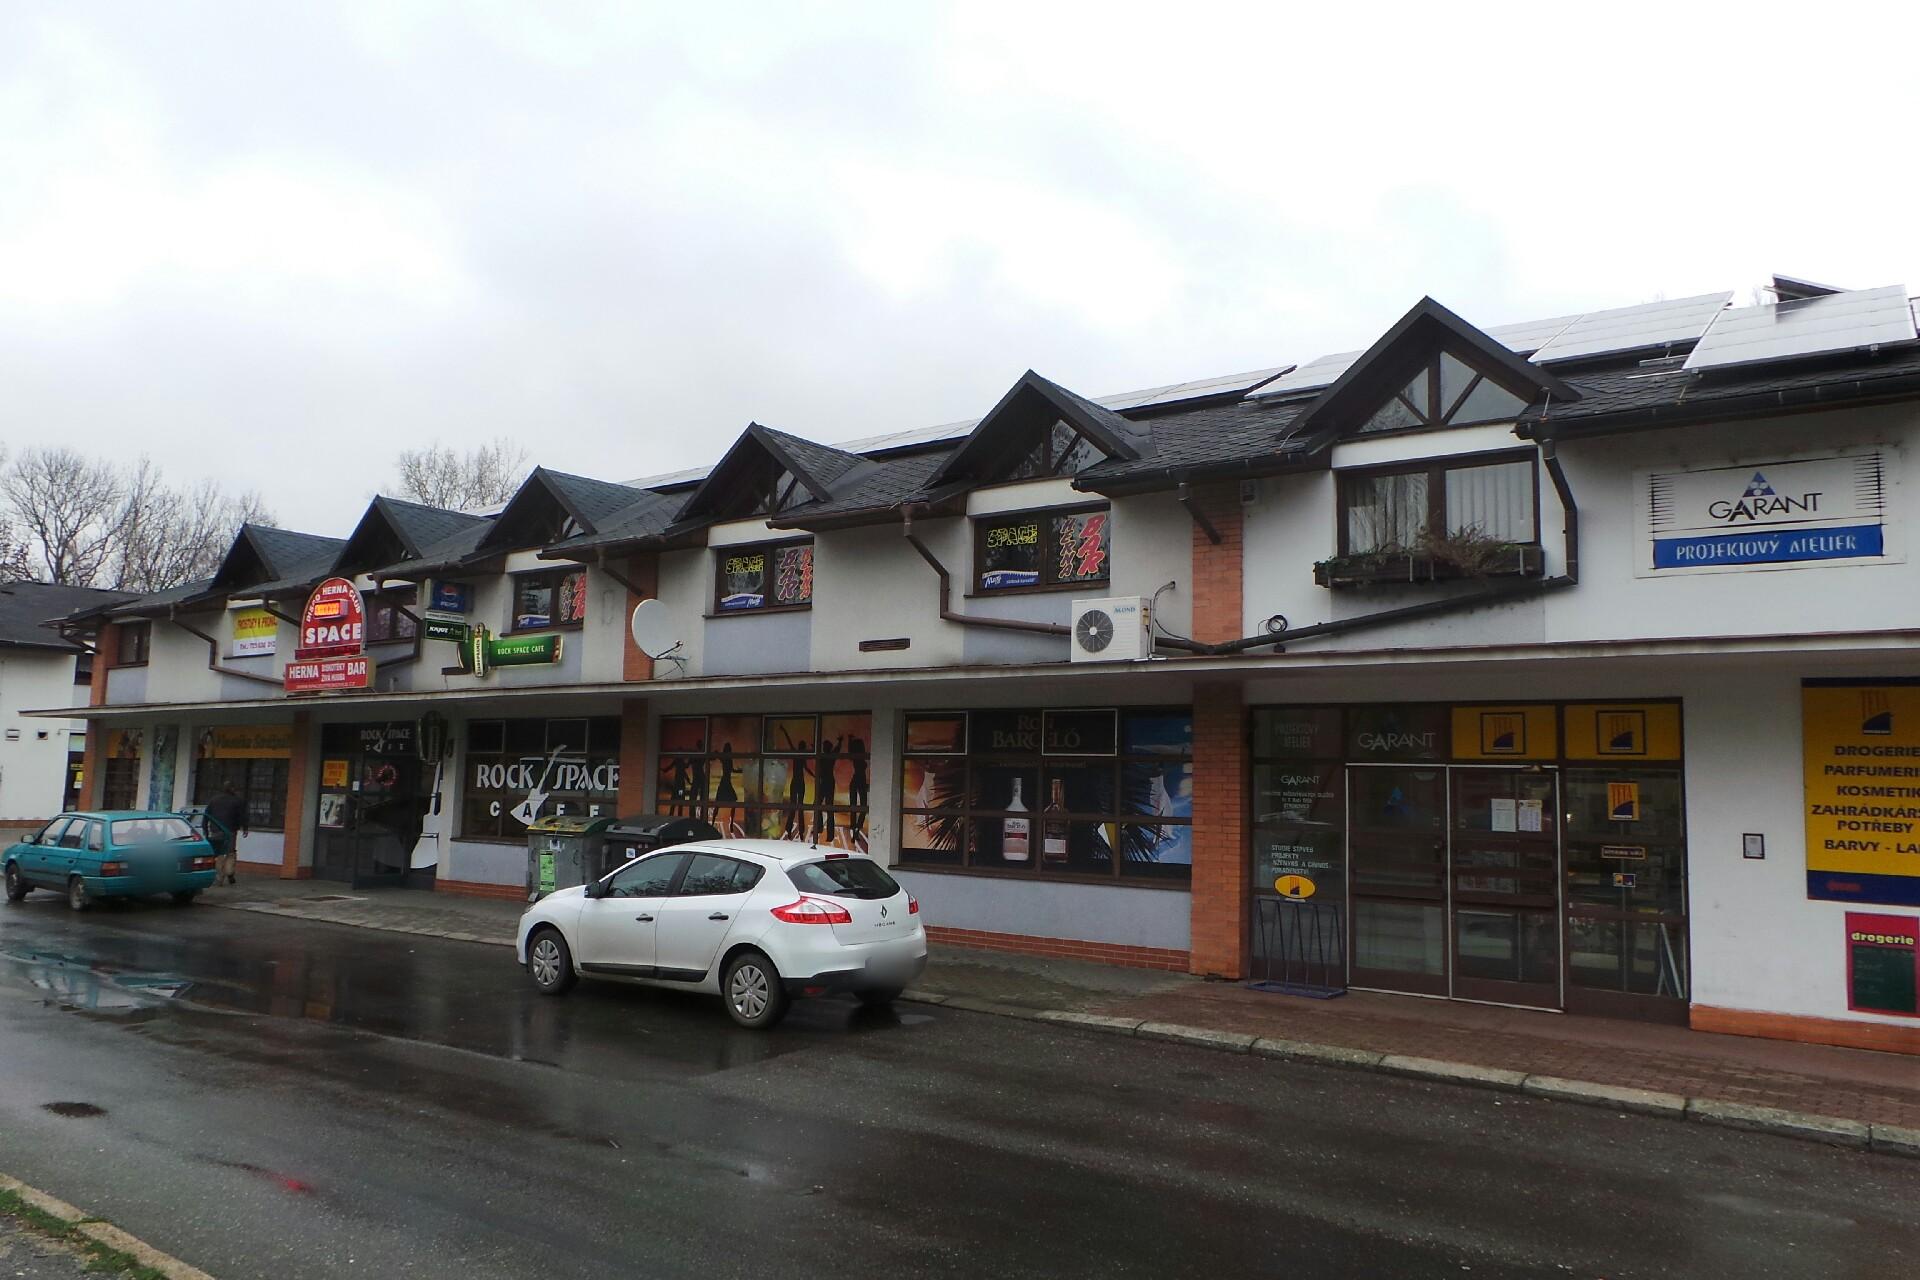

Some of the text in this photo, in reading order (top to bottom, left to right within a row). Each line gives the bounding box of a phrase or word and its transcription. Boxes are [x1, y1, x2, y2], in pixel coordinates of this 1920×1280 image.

[1708, 492, 1823, 522] GARANT
[986, 524, 1038, 548] SPACE
[1077, 514, 1107, 576] BAR
[1058, 518, 1076, 579] HERNA
[1676, 534, 1856, 560] PROJEKTOVÝ ATELIER
[725, 555, 764, 574] SPACE
[322, 584, 348, 596] HERNA
[348, 589, 361, 614] CLUB
[305, 623, 362, 644] SPACE
[497, 645, 545, 655] ROCK SPACE CAFE
[289, 661, 366, 679] HERNA BAR
[1358, 732, 1436, 750] GARANT
[1834, 746, 1920, 757] DROGERIE
[476, 764, 620, 791] ROCK SPACE
[1280, 775, 1321, 785] GARANT
[1811, 803, 1920, 818] ZAHRÁDKÁR
[1837, 819, 1914, 834] POTŘEBY
[1824, 840, 1880, 852] BARVY
[1896, 843, 1920, 854] LA
[1851, 932, 1914, 945] drogerie
